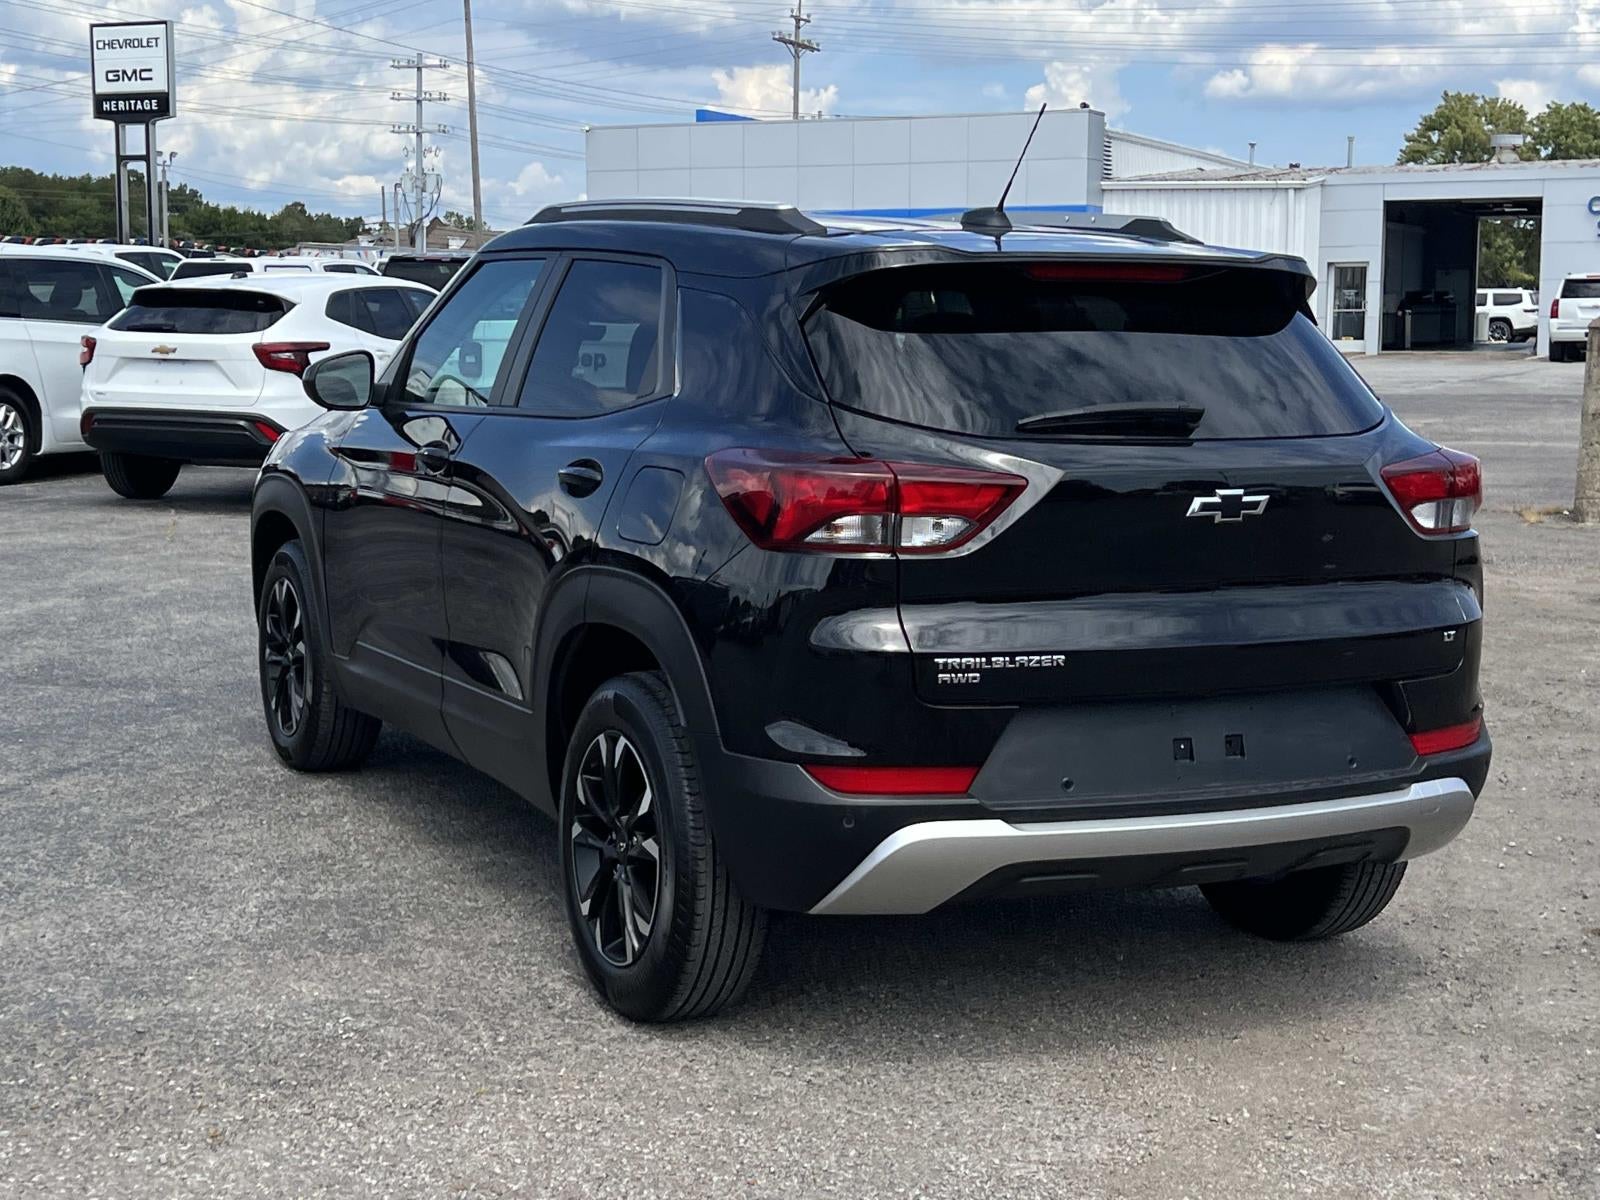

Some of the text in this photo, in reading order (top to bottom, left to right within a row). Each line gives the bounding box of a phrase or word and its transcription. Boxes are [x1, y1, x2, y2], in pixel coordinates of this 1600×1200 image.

[96, 37, 160, 50] CHEVROLET
[105, 68, 153, 82] GMC
[102, 99, 159, 111] HERITAGE
[1443, 630, 1457, 642] LT
[934, 655, 1066, 670] TRAILBLAZER
[937, 673, 980, 684] AWD
